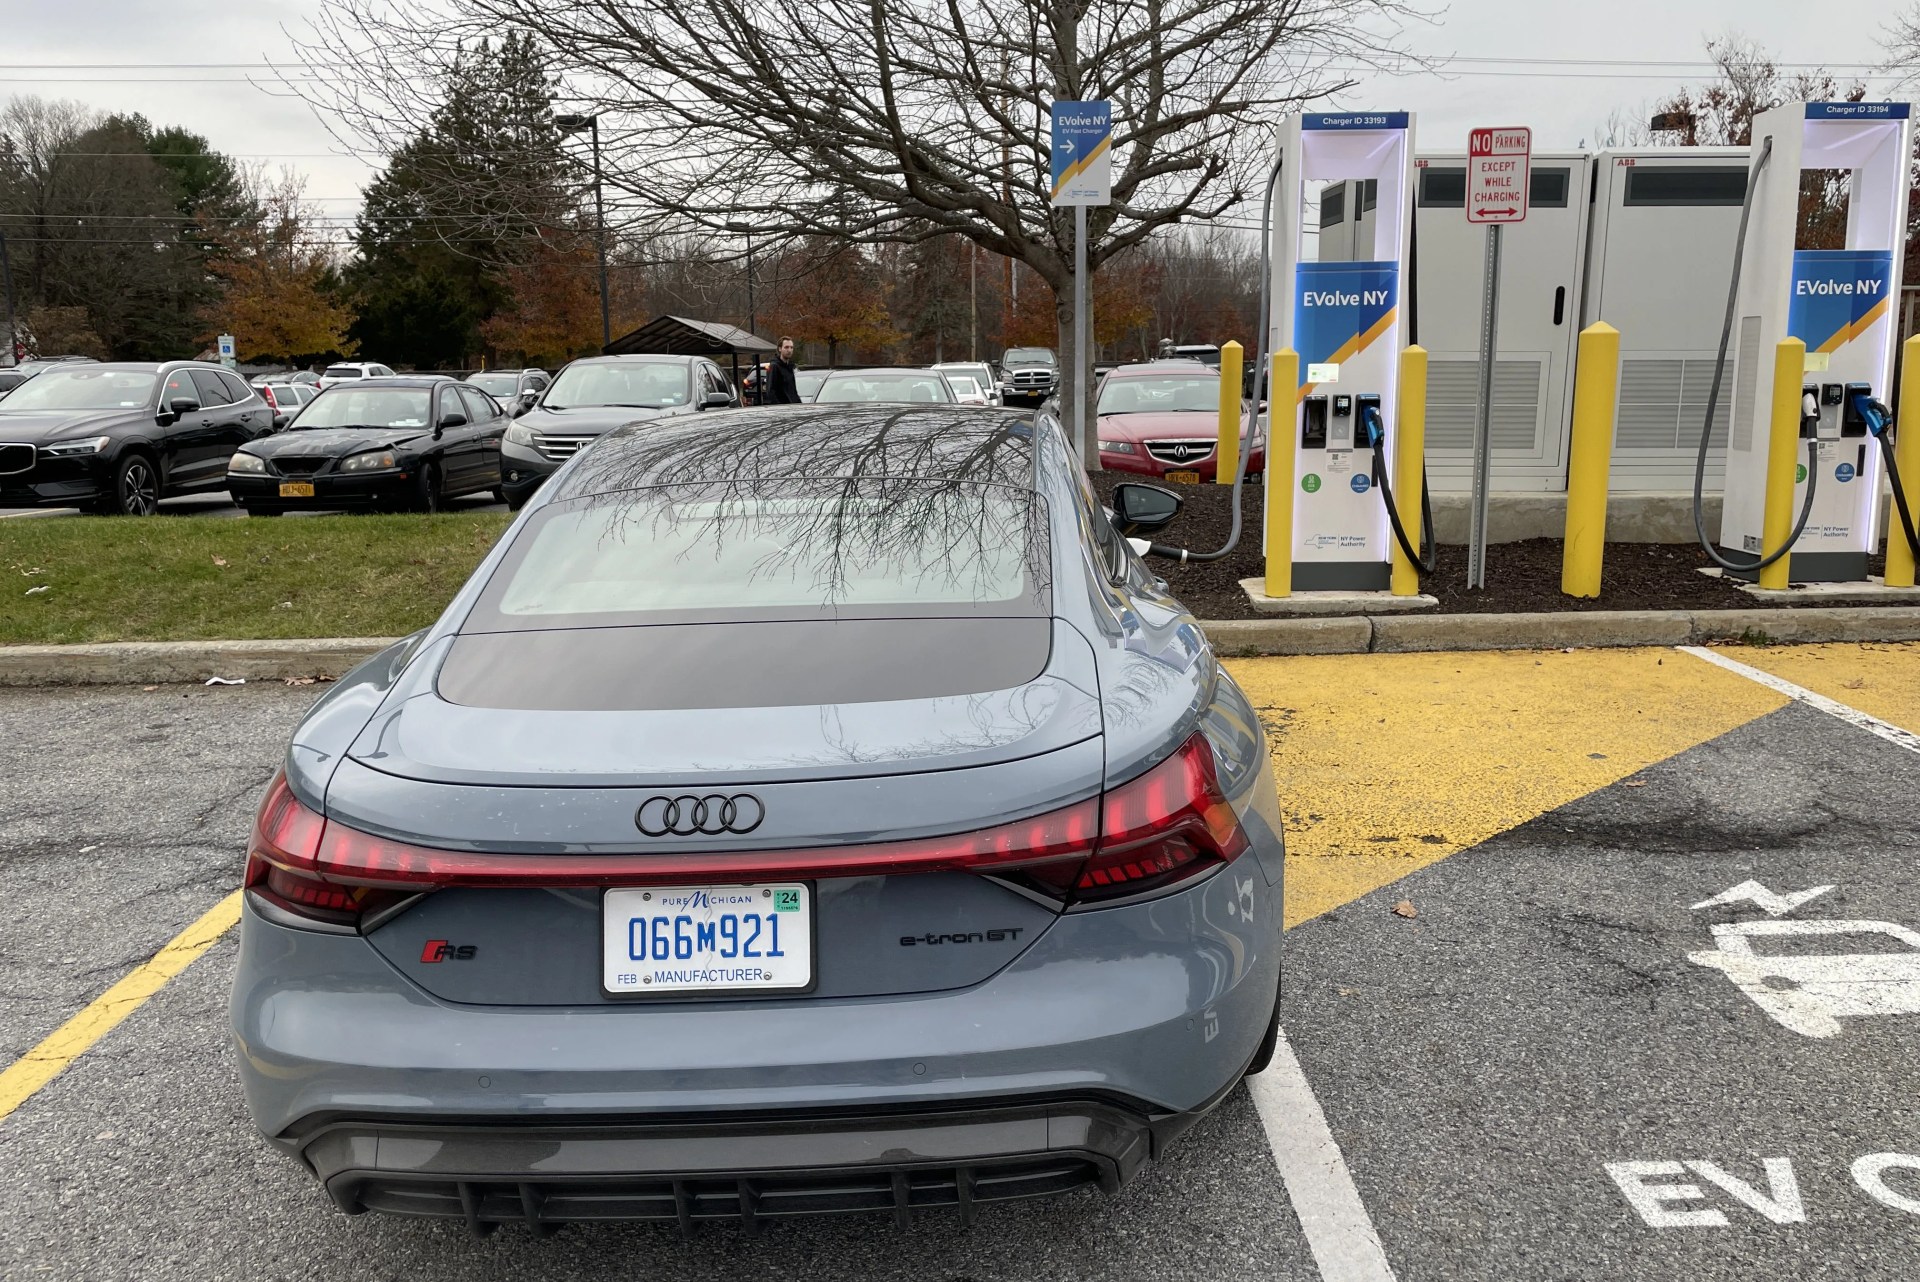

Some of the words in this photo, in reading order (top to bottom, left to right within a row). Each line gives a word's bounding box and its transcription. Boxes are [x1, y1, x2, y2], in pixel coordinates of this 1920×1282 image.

[1826, 105, 1856, 114] Charger
[1867, 105, 1889, 113] 33194
[1058, 115, 1091, 126] EVolve
[1093, 115, 1107, 125] NY
[1322, 117, 1352, 126] Charger
[1354, 117, 1362, 125] ID
[1472, 134, 1491, 152] NO
[1495, 136, 1526, 148] PARKING
[1481, 162, 1516, 172] EXCEPT
[1484, 177, 1512, 187] WHILE
[1474, 192, 1520, 202] CHARGING
[1796, 279, 1853, 295] EVolve
[1856, 279, 1881, 295] NY
[1303, 290, 1360, 307] EVolve
[1363, 290, 1389, 306] NY
[662, 898, 688, 906] PURE
[782, 892, 798, 904] 24
[628, 913, 784, 961] 066M921
[900, 932, 983, 947] e-tron
[986, 928, 1024, 941] GT
[429, 943, 478, 961] RS
[617, 974, 637, 984] FEB
[654, 968, 763, 983] MANUFACTURER
[1603, 1156, 1807, 1227] EV
